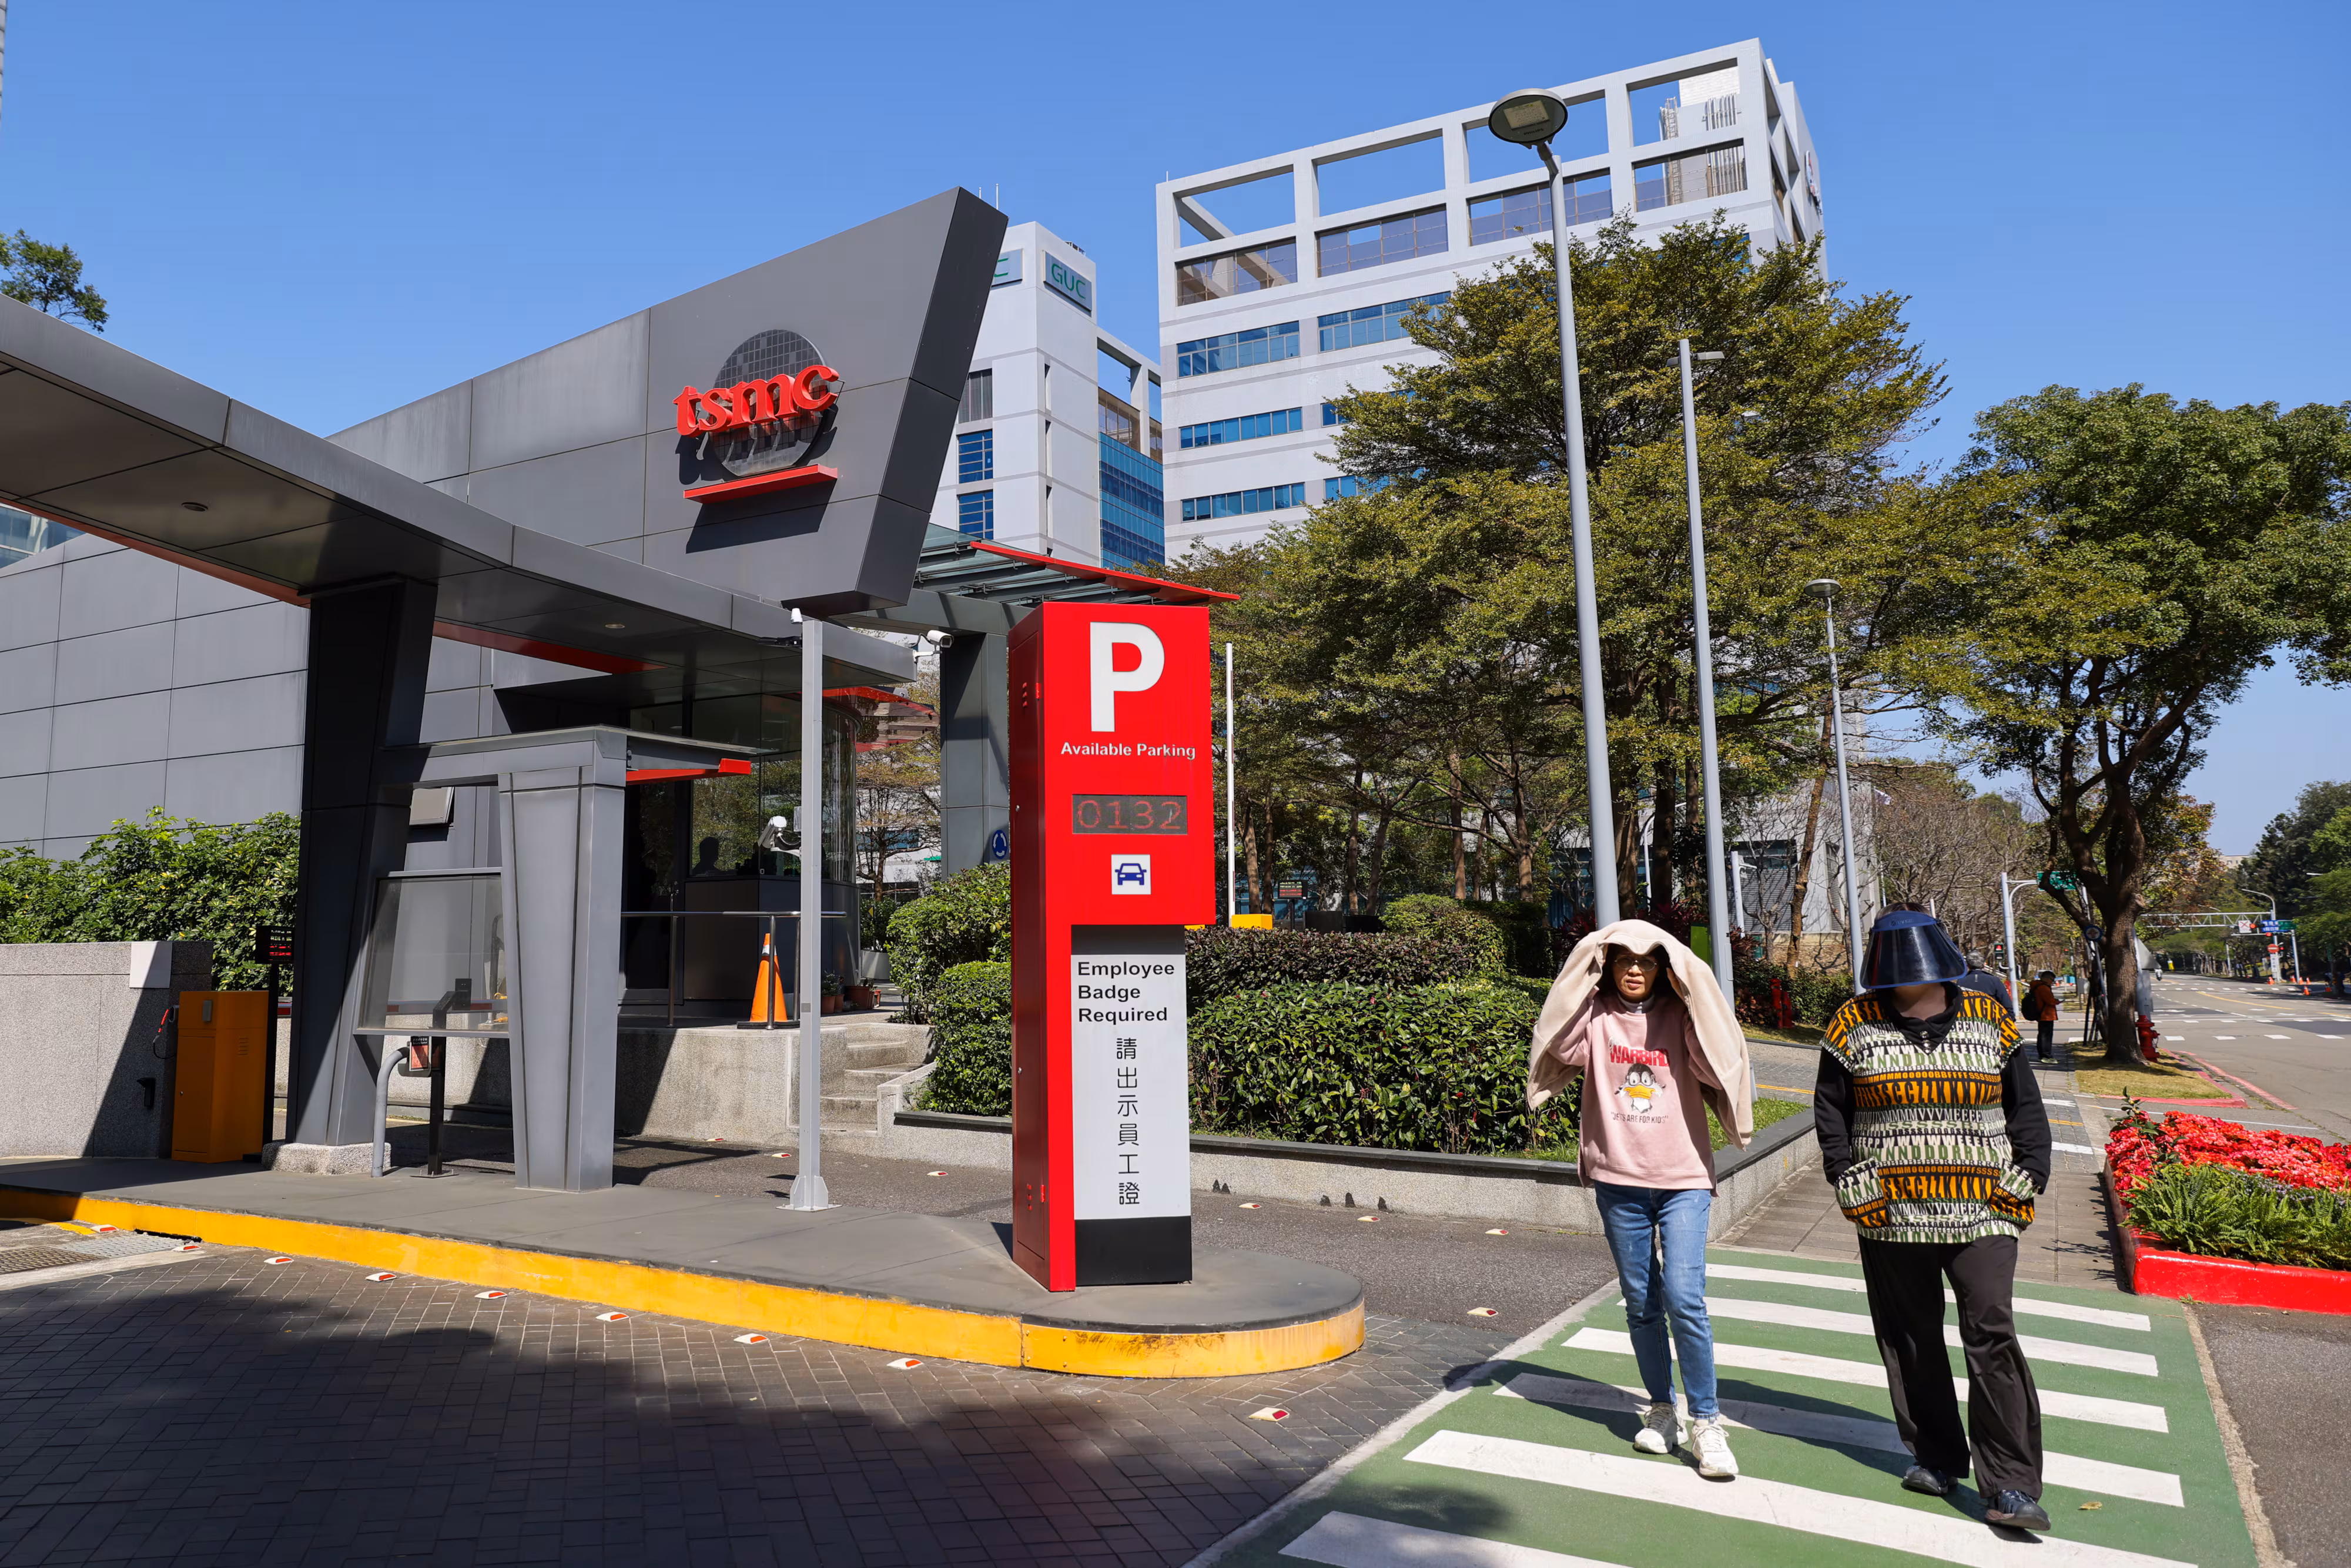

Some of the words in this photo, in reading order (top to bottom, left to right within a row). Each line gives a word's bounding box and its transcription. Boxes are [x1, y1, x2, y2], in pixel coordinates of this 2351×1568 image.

[1051, 263, 1086, 300] GUC
[672, 364, 839, 438] tsmc
[1090, 621, 1165, 732] P
[1061, 742, 1132, 756] Available
[1137, 743, 1196, 760] Parking
[1077, 800, 1181, 830] 0132
[1077, 961, 1175, 979] Employee
[1078, 985, 1141, 1001] Badge
[1079, 1007, 1168, 1025] Required
[1116, 1037, 1140, 1205] 請出示員工證
[1626, 1114, 1638, 1123] ARE
[1639, 1115, 1650, 1124] FOR
